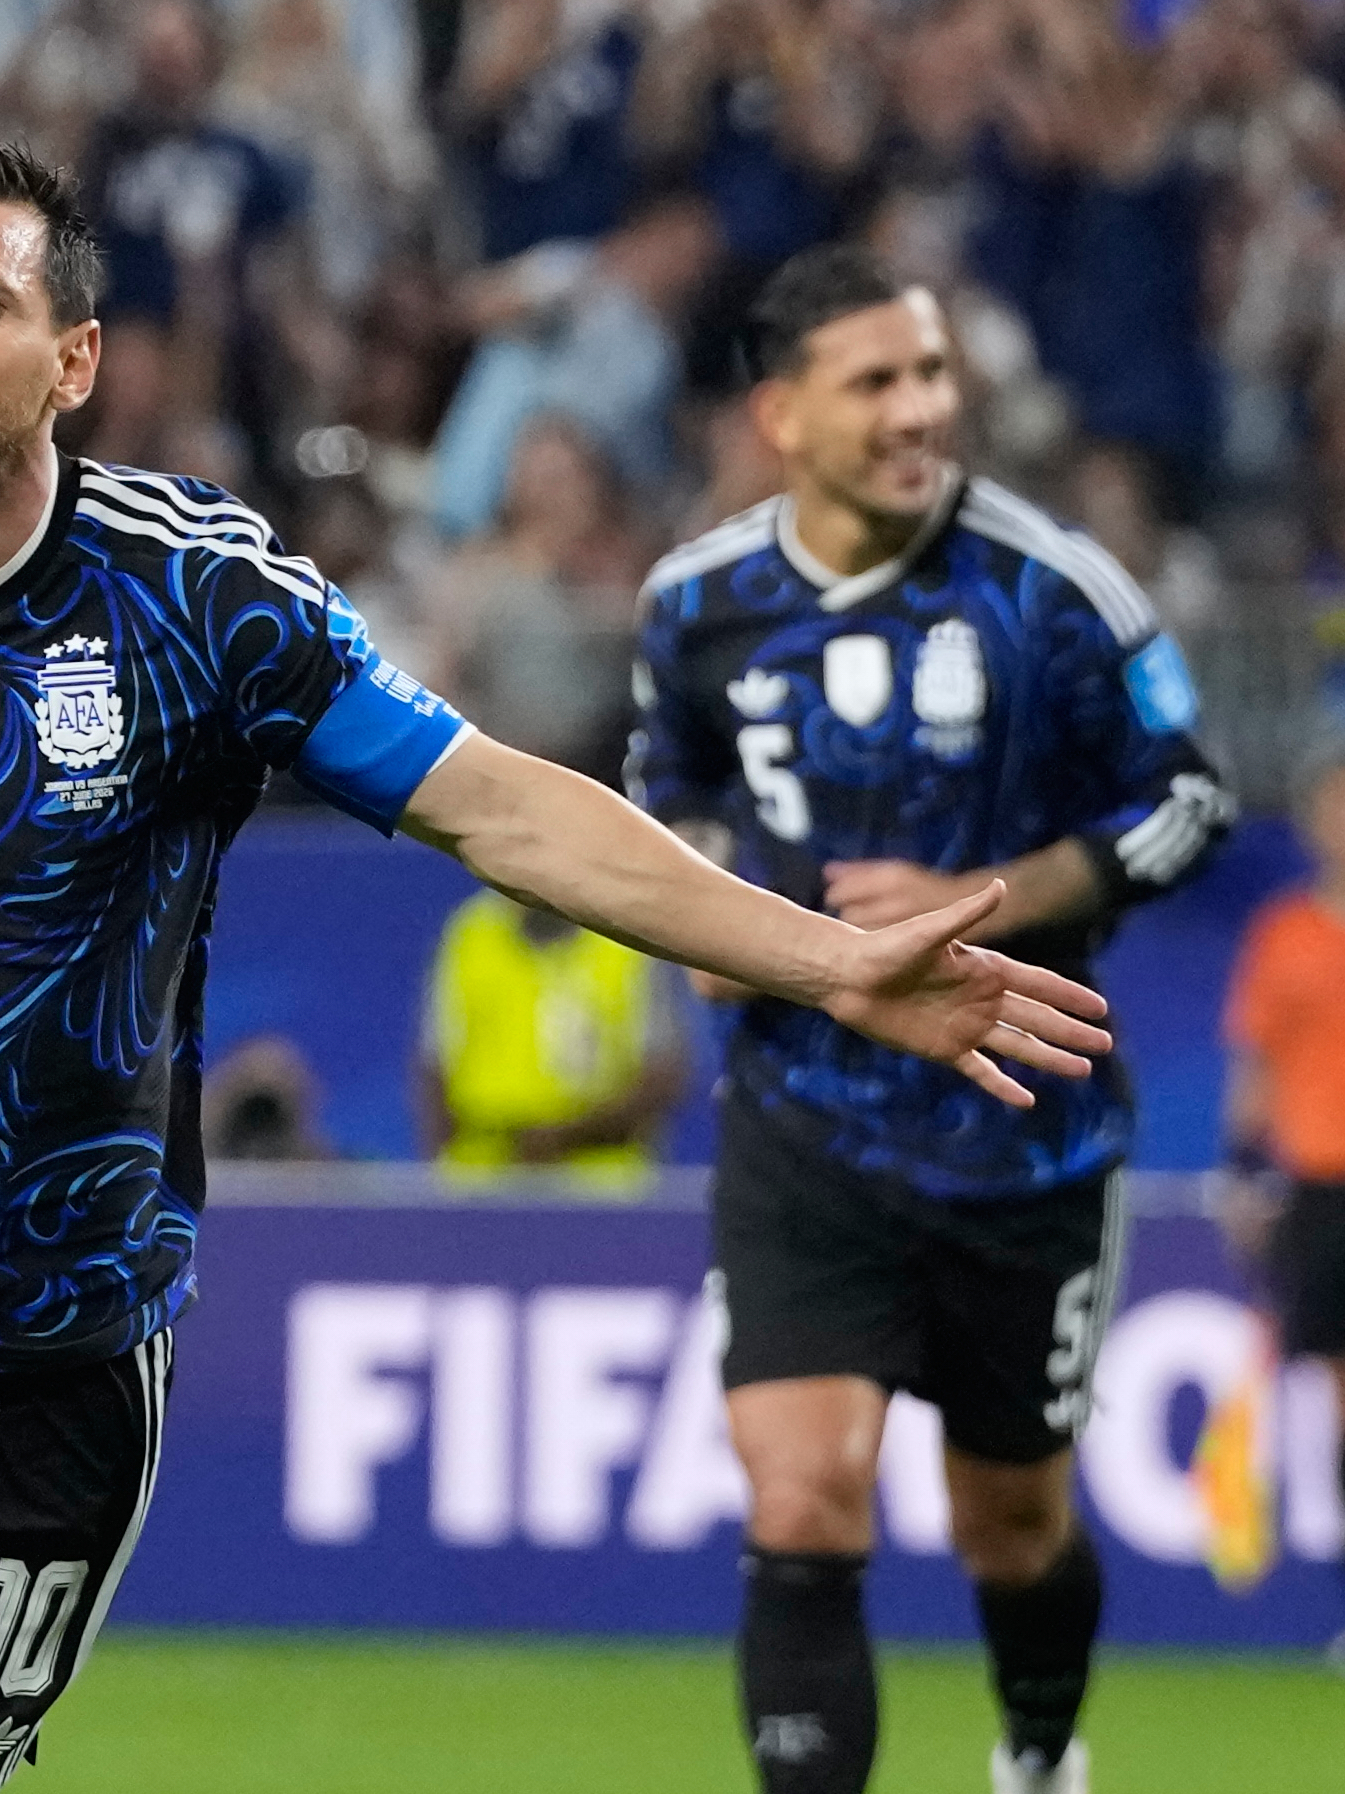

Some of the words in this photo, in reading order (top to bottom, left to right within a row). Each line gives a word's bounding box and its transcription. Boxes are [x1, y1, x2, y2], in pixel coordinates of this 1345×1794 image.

[56, 690, 104, 736] AFA
[92, 787, 114, 798] 2026
[736, 723, 812, 842] 5
